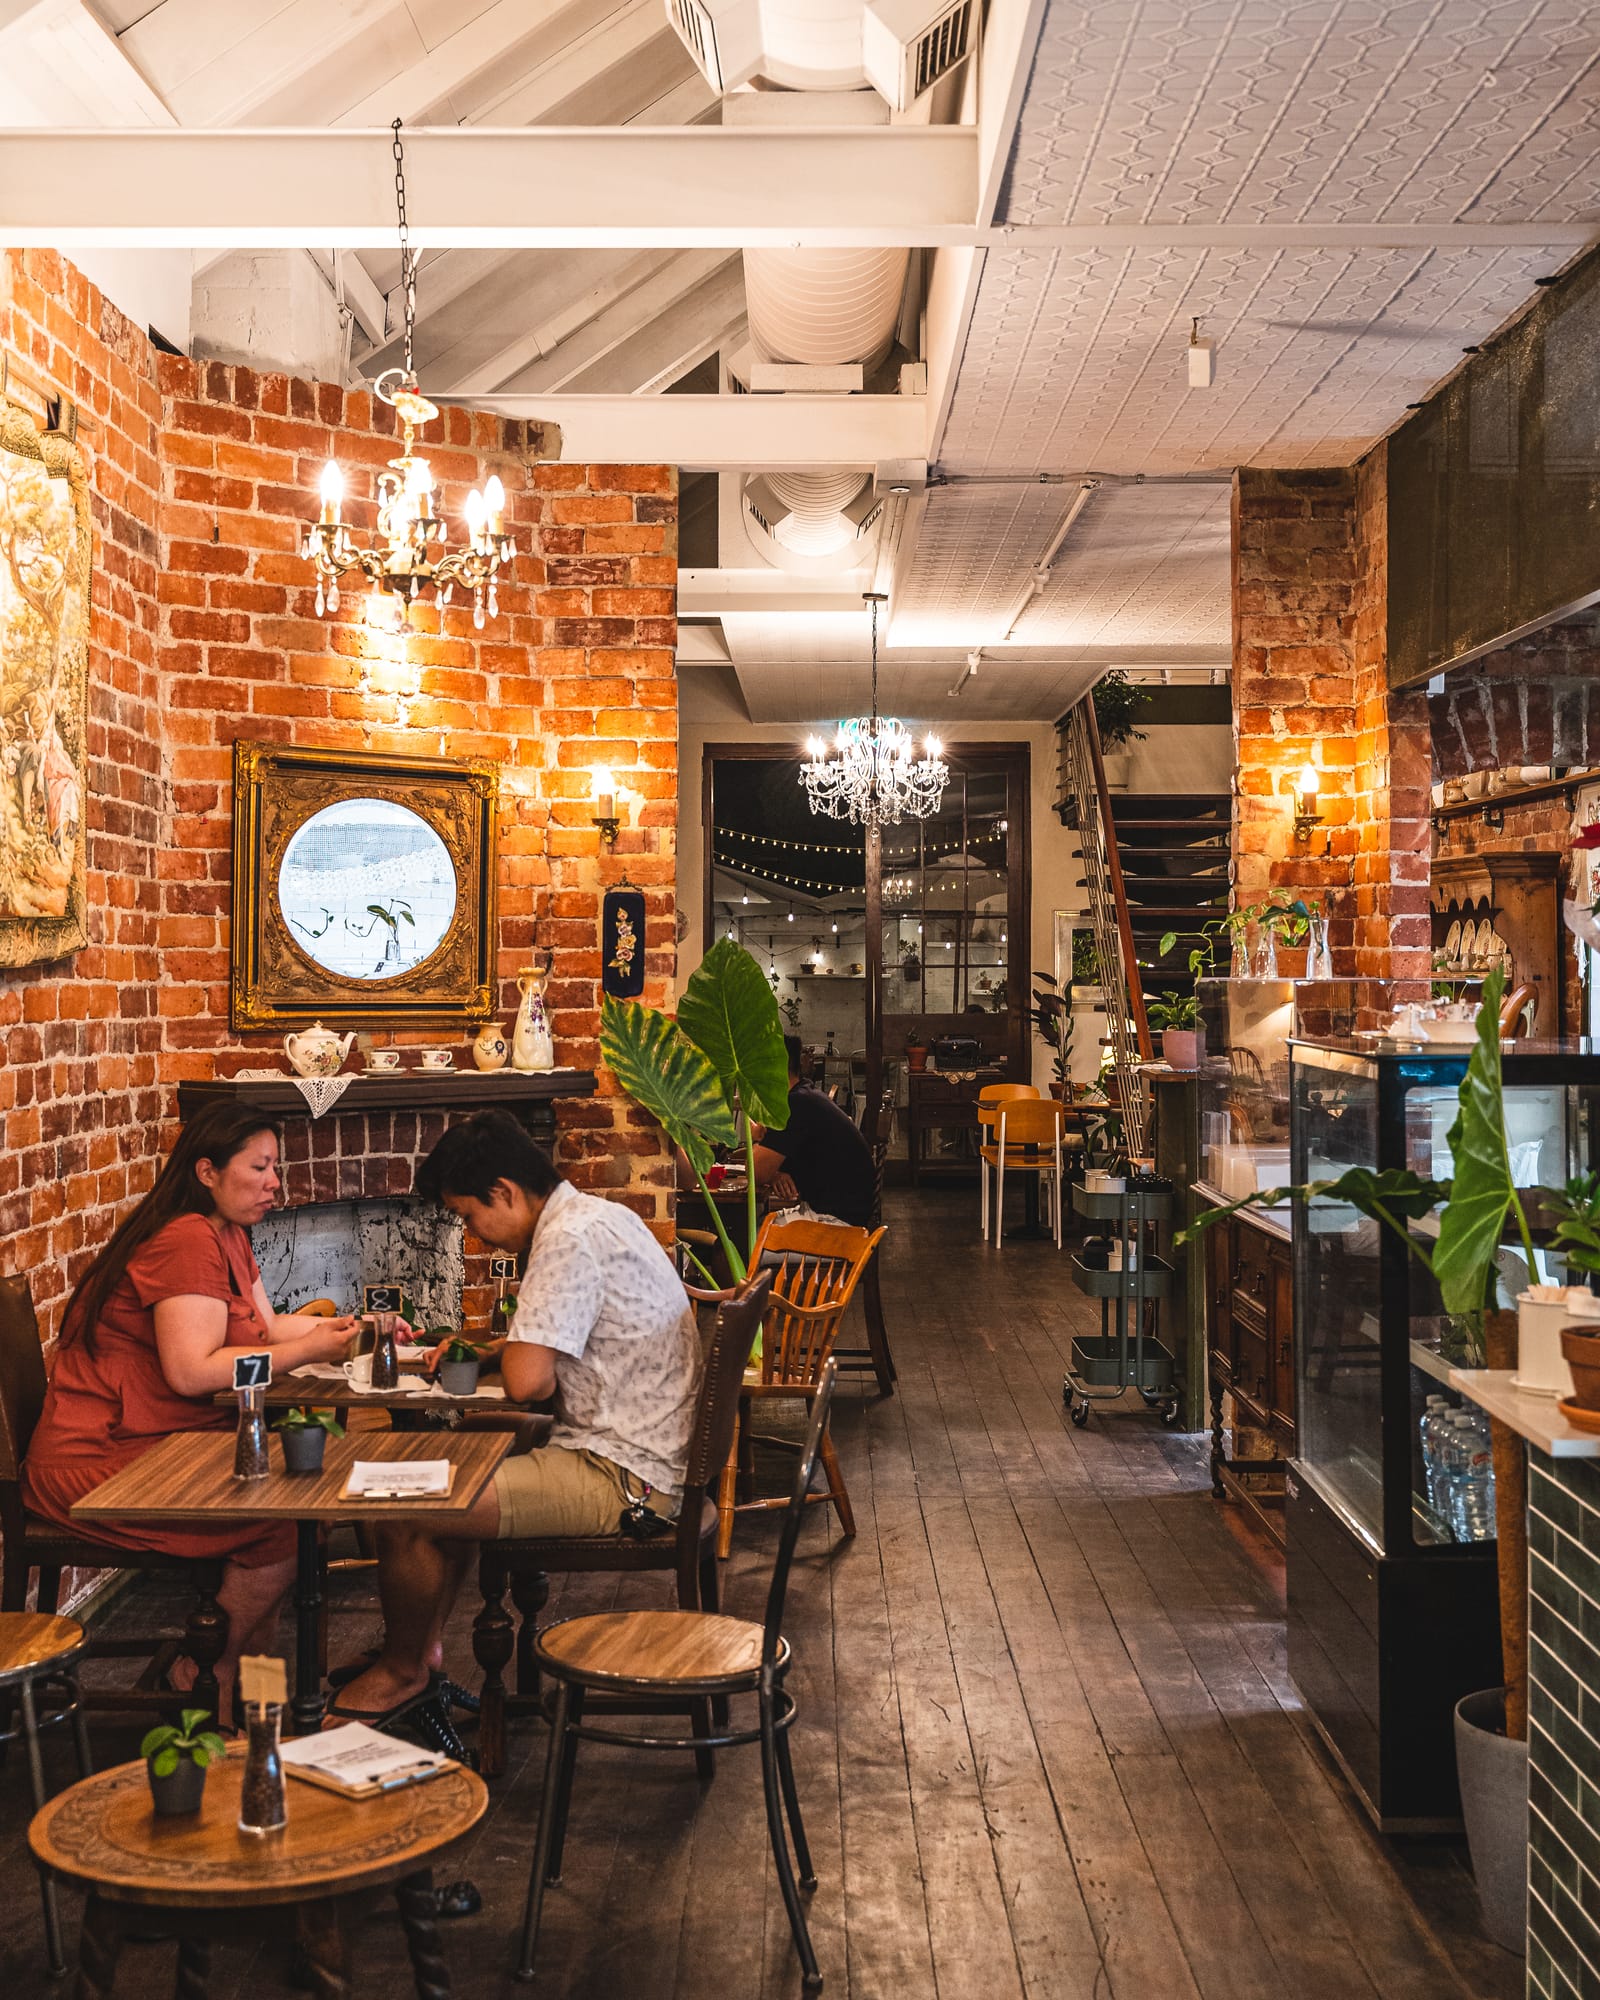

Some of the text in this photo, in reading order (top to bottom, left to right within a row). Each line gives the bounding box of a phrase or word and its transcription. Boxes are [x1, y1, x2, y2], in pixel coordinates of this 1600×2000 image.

[495, 1260, 506, 1278] 9
[371, 1289, 392, 1311] 8
[243, 1359, 261, 1385] 7
